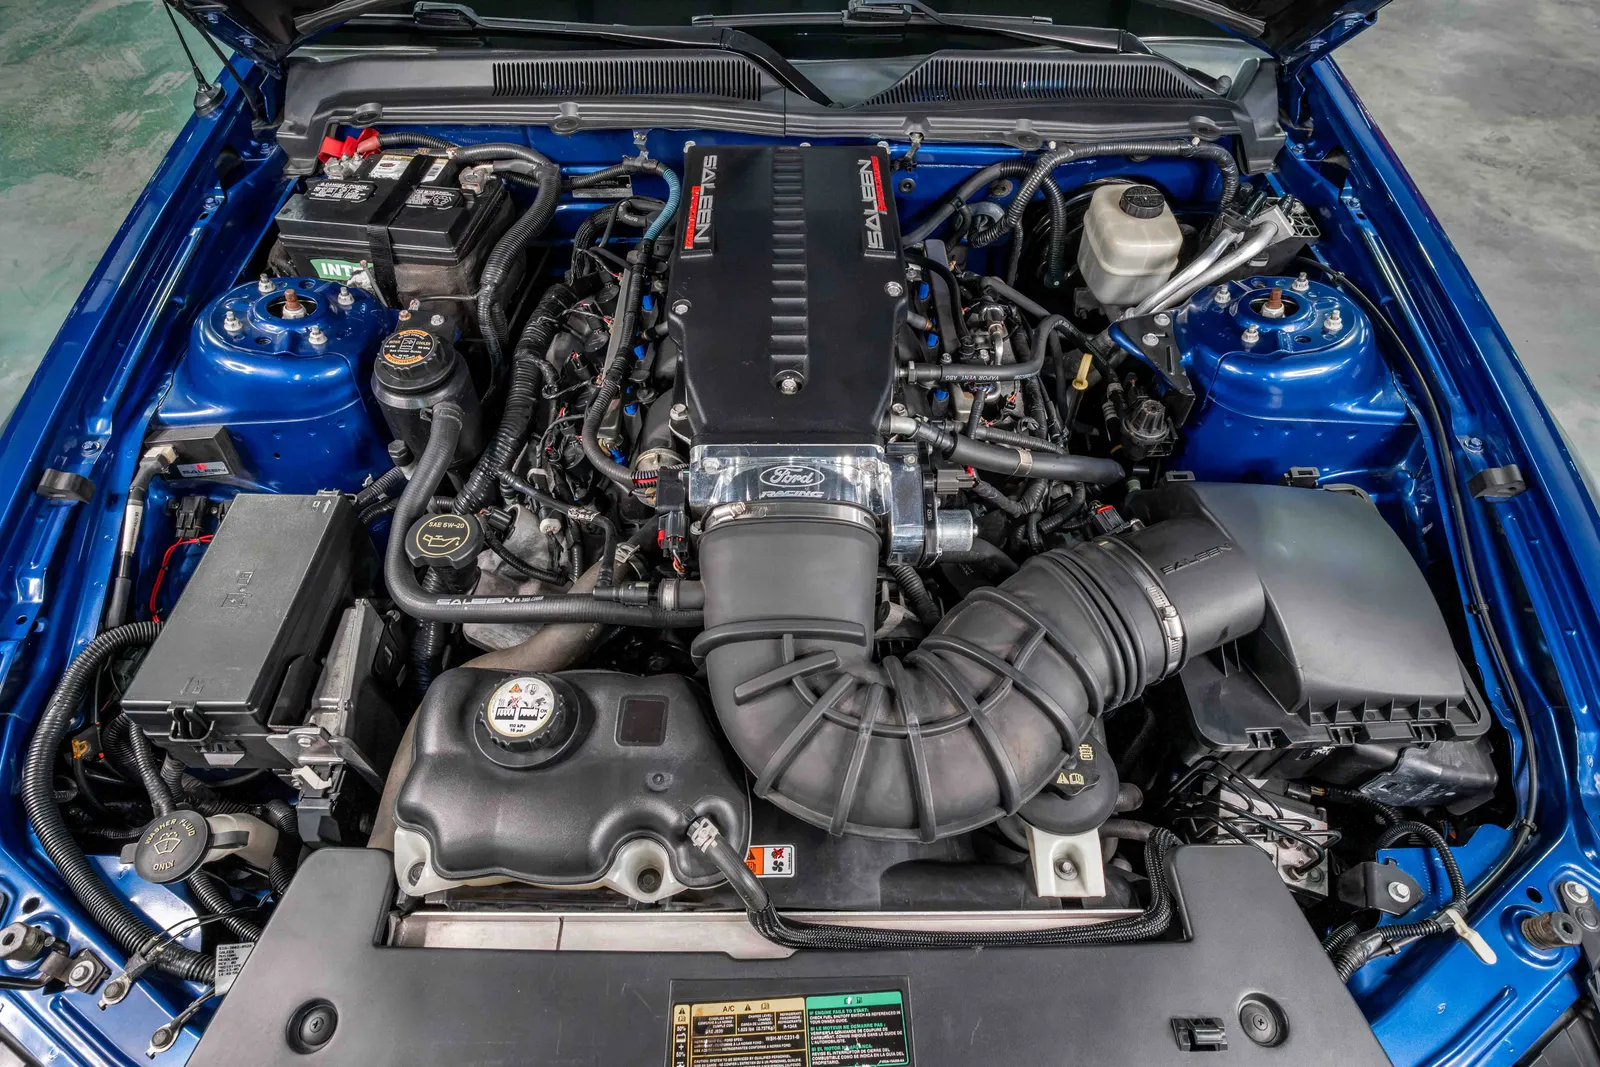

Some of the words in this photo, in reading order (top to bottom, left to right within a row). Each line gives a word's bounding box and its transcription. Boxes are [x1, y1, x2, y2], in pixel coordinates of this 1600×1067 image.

[694, 154, 718, 244] SALEEN
[857, 158, 885, 249] SALEEN
[769, 467, 814, 485] Ford
[760, 490, 825, 499] RACING
[1160, 543, 1232, 575] SALEEN
[436, 597, 515, 605] SALEEN
[145, 818, 177, 844] WASHER
[179, 818, 197, 837] FLUID
[153, 860, 176, 871] ONLY
